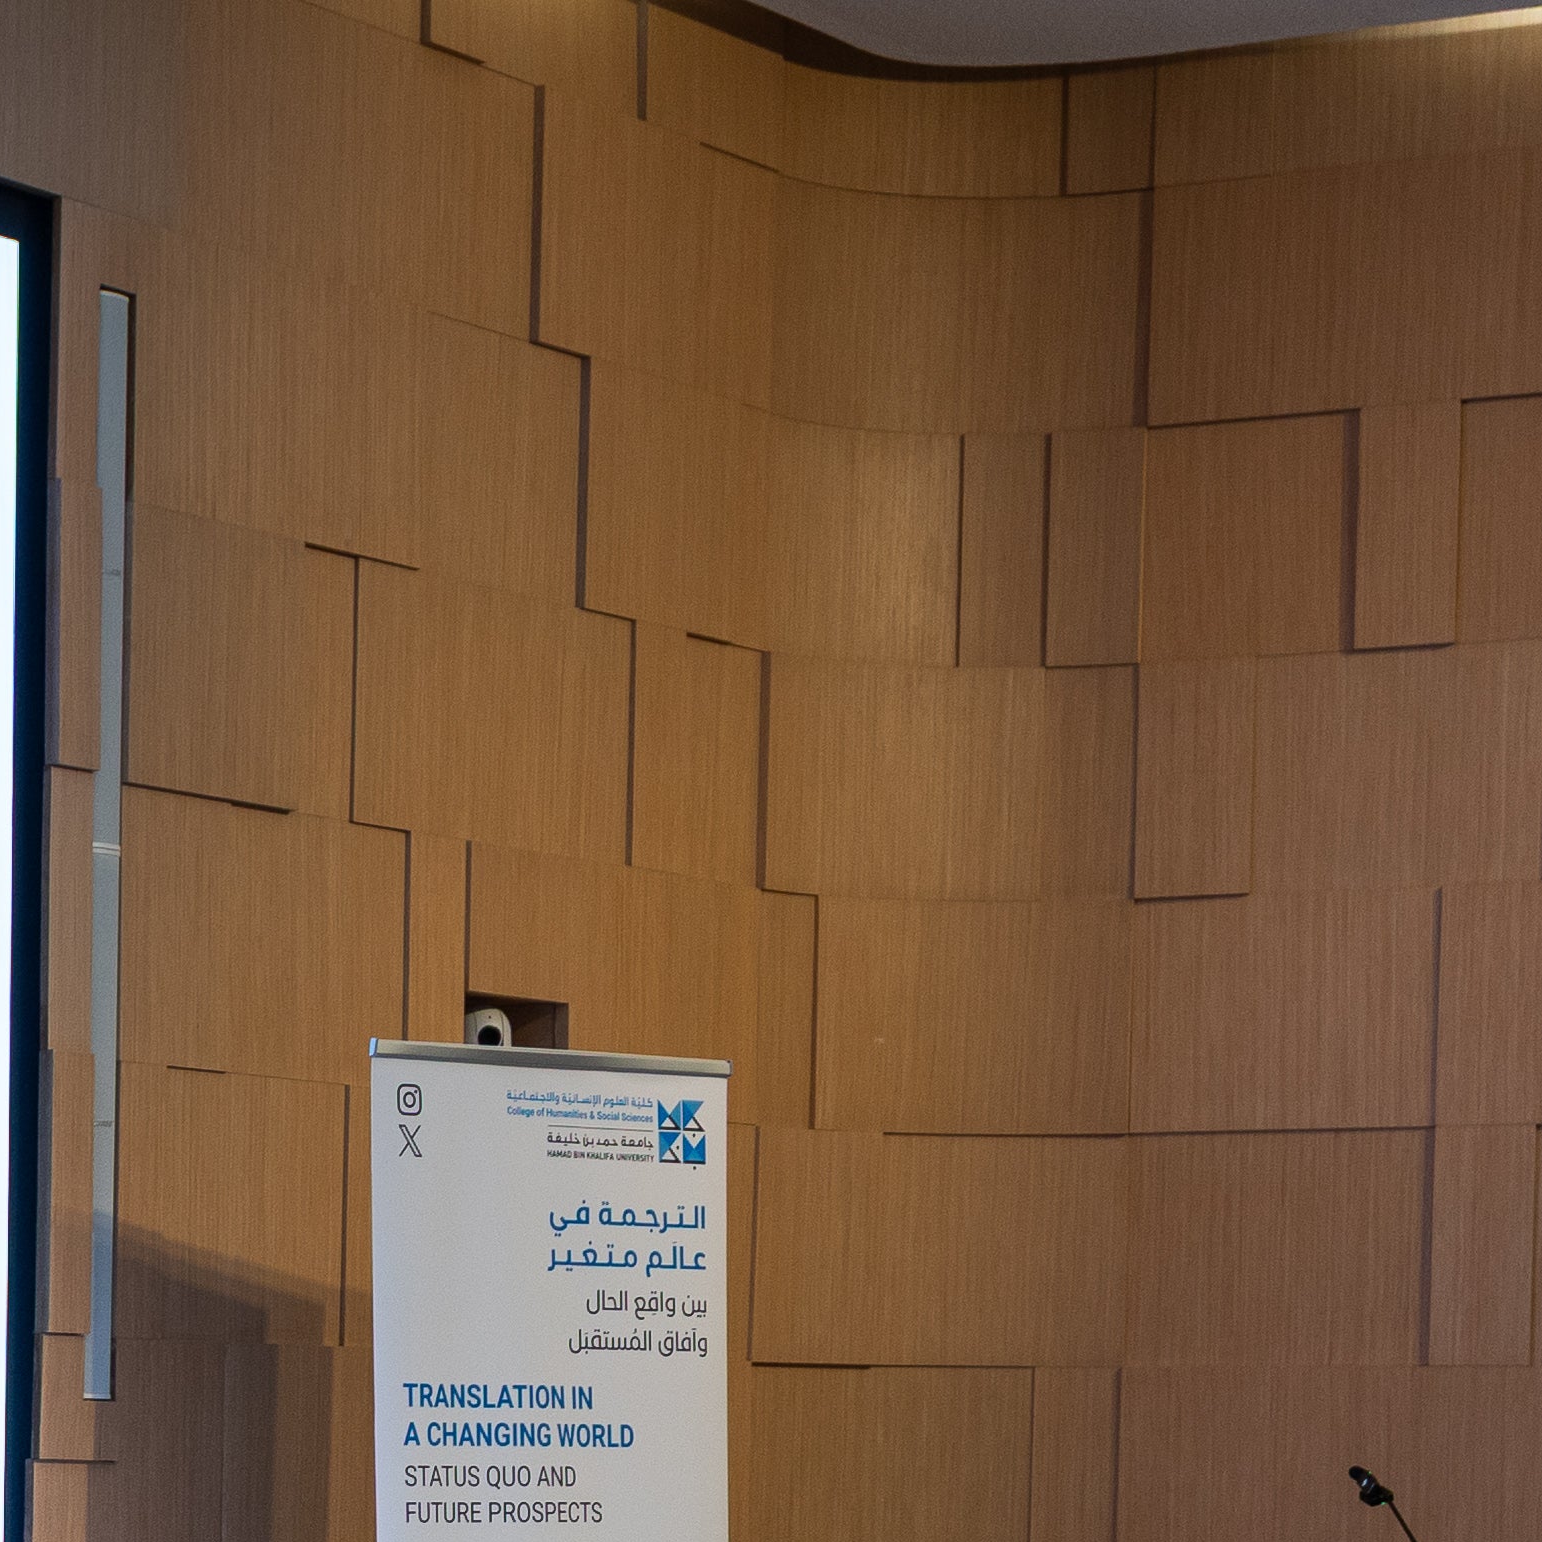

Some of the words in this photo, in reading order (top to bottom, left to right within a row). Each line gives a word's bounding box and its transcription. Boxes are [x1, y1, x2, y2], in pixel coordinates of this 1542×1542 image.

[507, 1106, 534, 1118] College
[546, 1108, 587, 1119] Humanities
[597, 1111, 620, 1121] Social
[621, 1112, 654, 1123] Sciences
[547, 1132, 580, 1146] خليفة
[583, 1134, 595, 1148] بن
[596, 1137, 618, 1147] حمد
[621, 1135, 654, 1151] جامعة
[547, 1149, 572, 1159] HAMAD
[573, 1151, 585, 1159] BIN
[586, 1151, 615, 1161] KHALIFA
[616, 1152, 655, 1163] UNIVERSITY
[549, 1199, 590, 1238] في
[598, 1200, 706, 1234] الترجمة
[547, 1240, 638, 1272] متغير
[586, 1289, 628, 1315] الحال
[681, 1294, 707, 1319] بين
[402, 1382, 565, 1409] TRANSLATION
[571, 1385, 593, 1410] IN
[403, 1421, 421, 1446] A
[427, 1421, 552, 1448] CHANGING
[556, 1423, 634, 1448] WORLD
[404, 1464, 480, 1488] STATUS
[486, 1465, 532, 1490] QUO
[536, 1465, 577, 1488] AND
[405, 1501, 483, 1524] FUTURE
[488, 1501, 603, 1524] PROSPECTS
